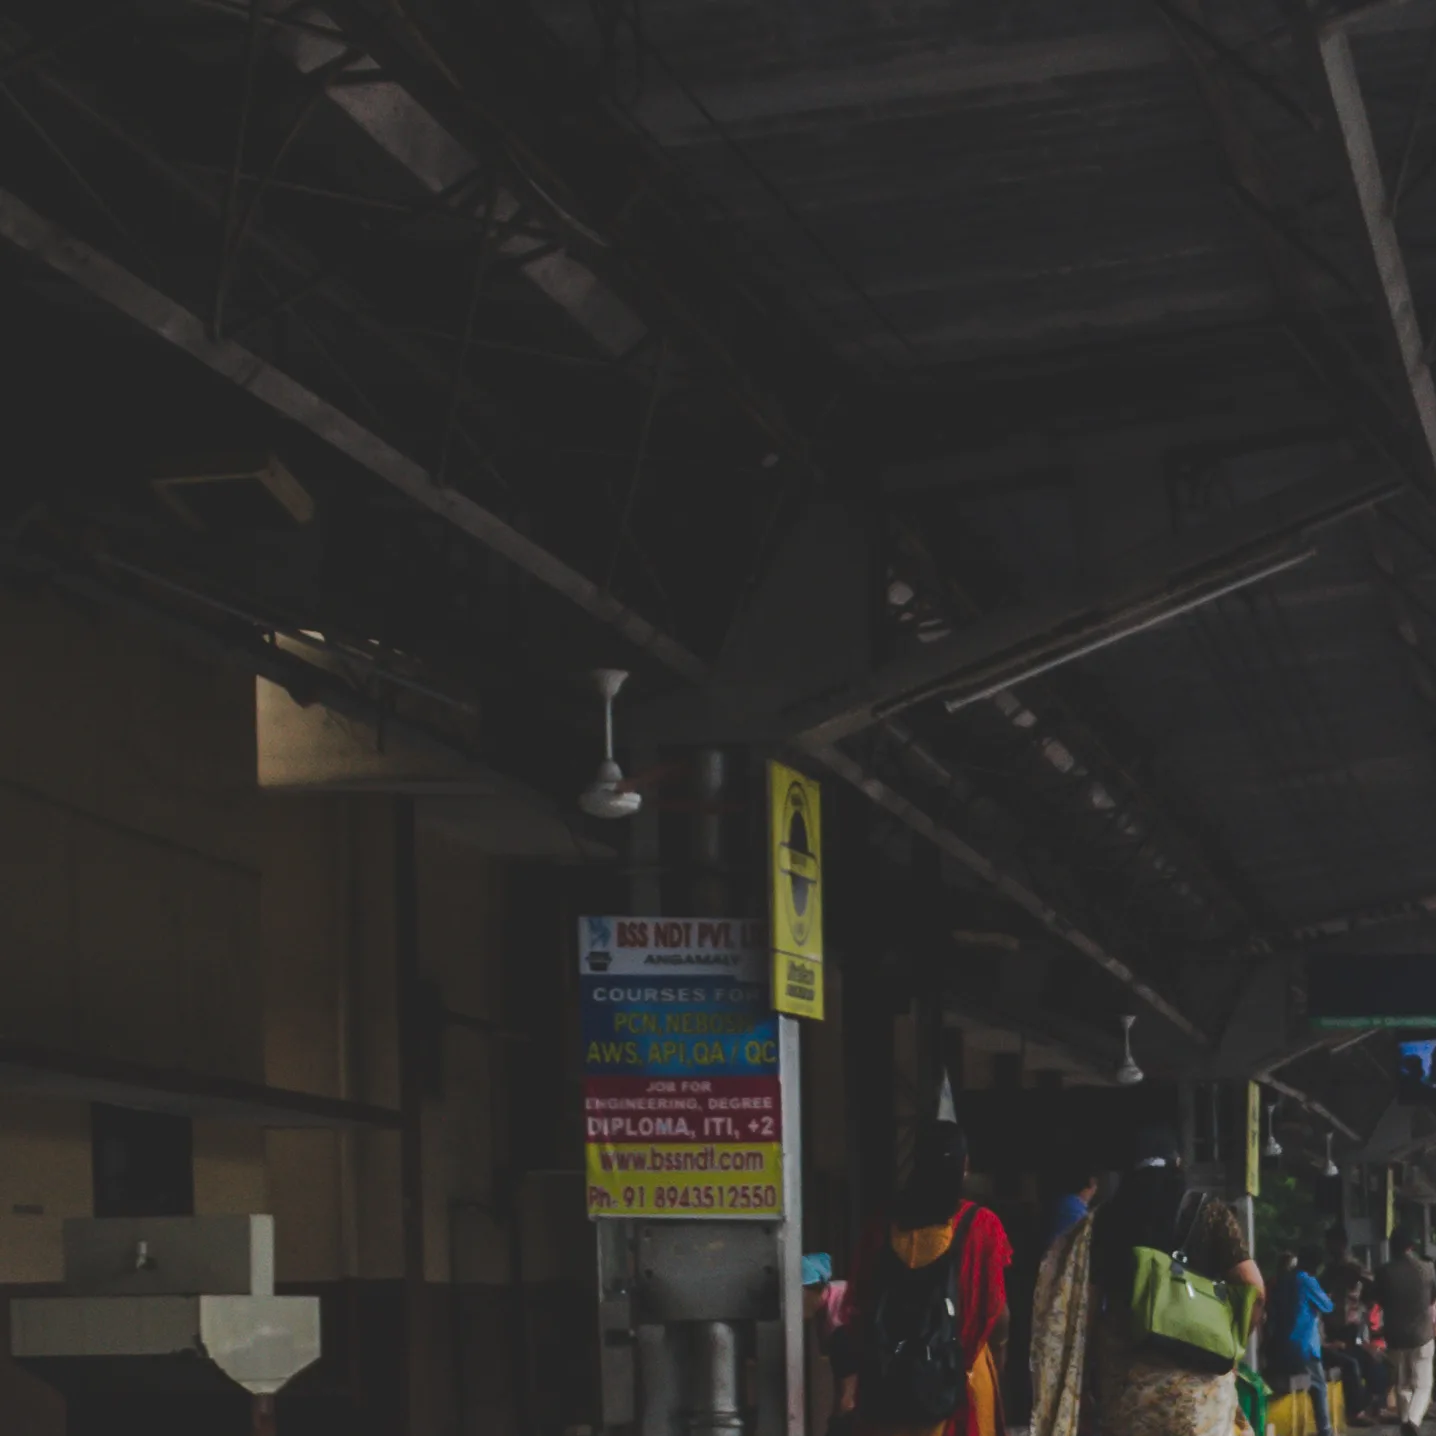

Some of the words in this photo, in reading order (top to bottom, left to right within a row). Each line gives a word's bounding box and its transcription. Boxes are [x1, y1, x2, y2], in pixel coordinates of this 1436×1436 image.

[616, 922, 648, 948] BSS
[653, 922, 691, 948] NDT
[643, 954, 741, 966] ANGAMALY
[592, 986, 706, 1002] COURSES
[714, 986, 760, 1002] FOR
[645, 1081, 677, 1093] JOB
[681, 1081, 713, 1093] FOR
[707, 1097, 773, 1110] DEGREE
[586, 1116, 697, 1139] DIPLOMA,
[747, 1116, 775, 1137] +2
[622, 1185, 645, 1208] 91
[653, 1184, 778, 1208] 8943512550
